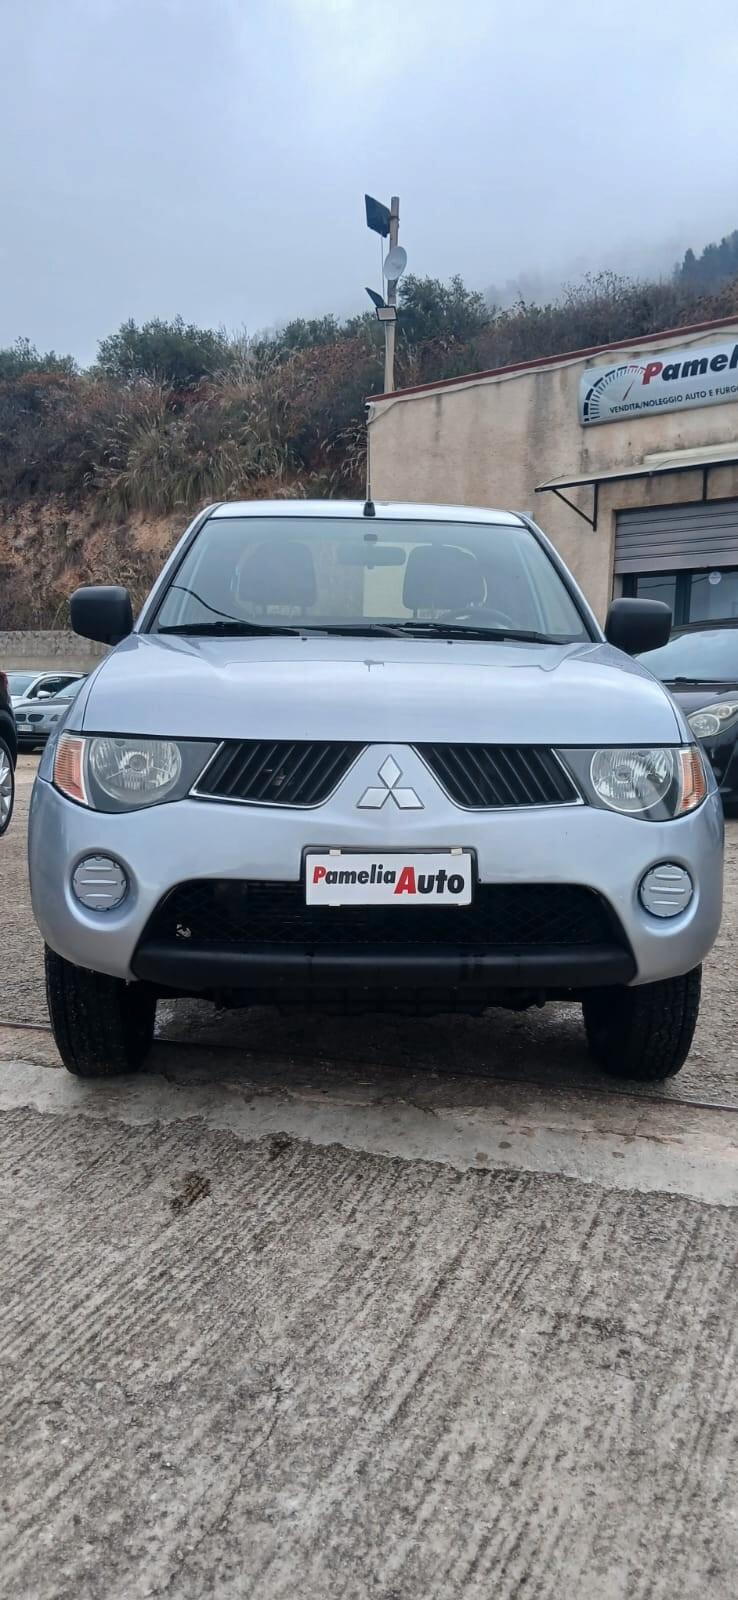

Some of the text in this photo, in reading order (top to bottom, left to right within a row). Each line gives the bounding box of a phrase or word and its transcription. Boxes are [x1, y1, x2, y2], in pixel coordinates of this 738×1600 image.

[609, 385, 738, 414] VENDITA/NOLEGGIO AUTO E FURG
